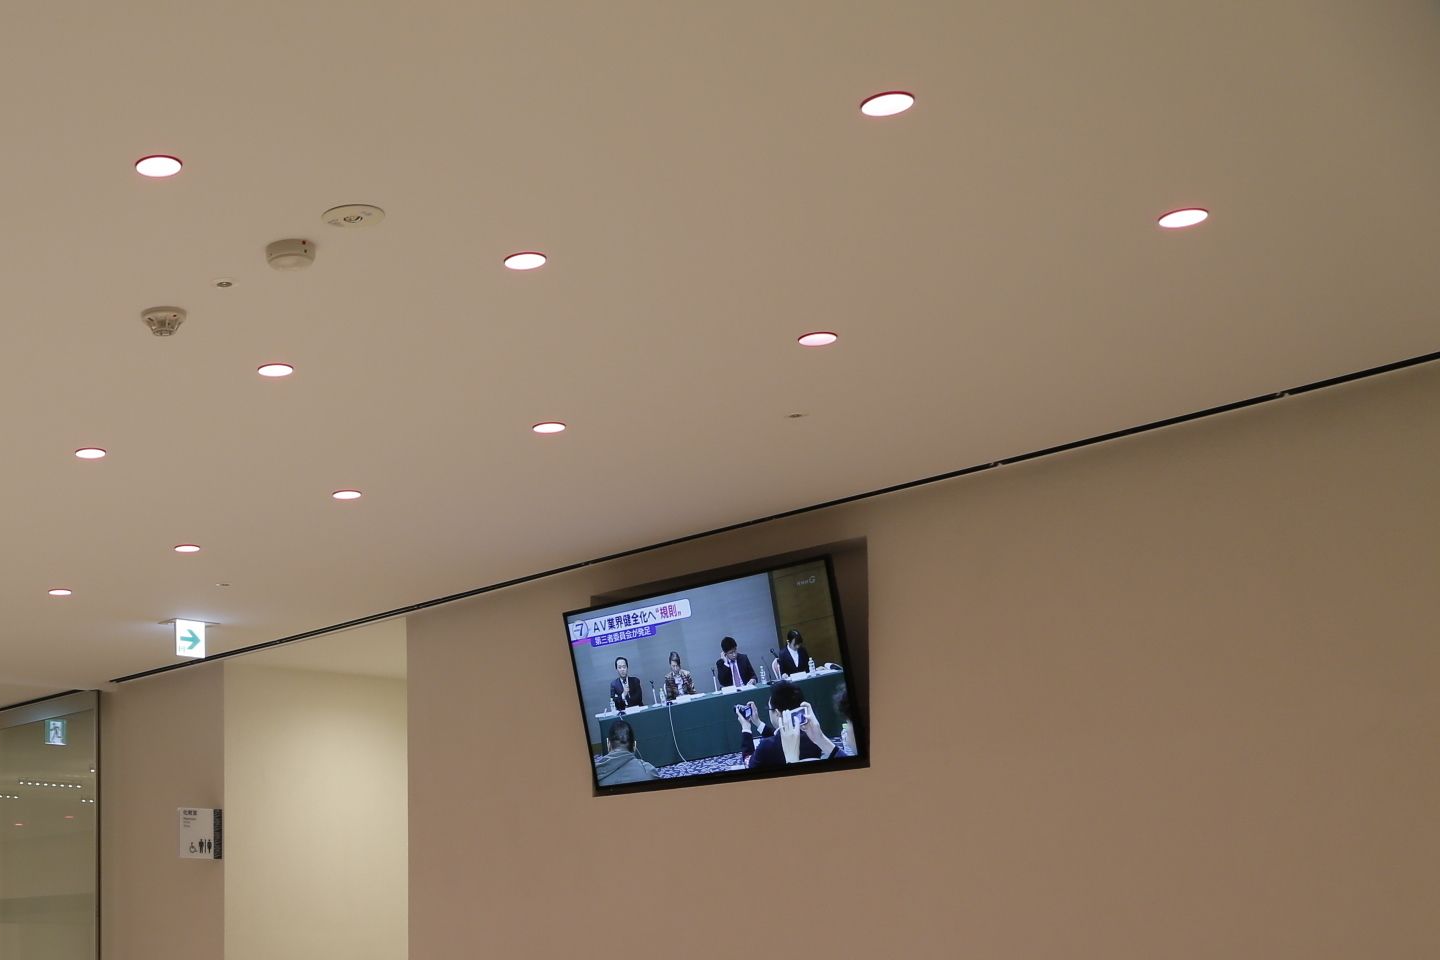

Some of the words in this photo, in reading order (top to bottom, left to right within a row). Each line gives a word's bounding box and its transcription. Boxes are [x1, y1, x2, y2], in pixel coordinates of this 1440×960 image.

[594, 626, 652, 646] 第三者委員会が発足
